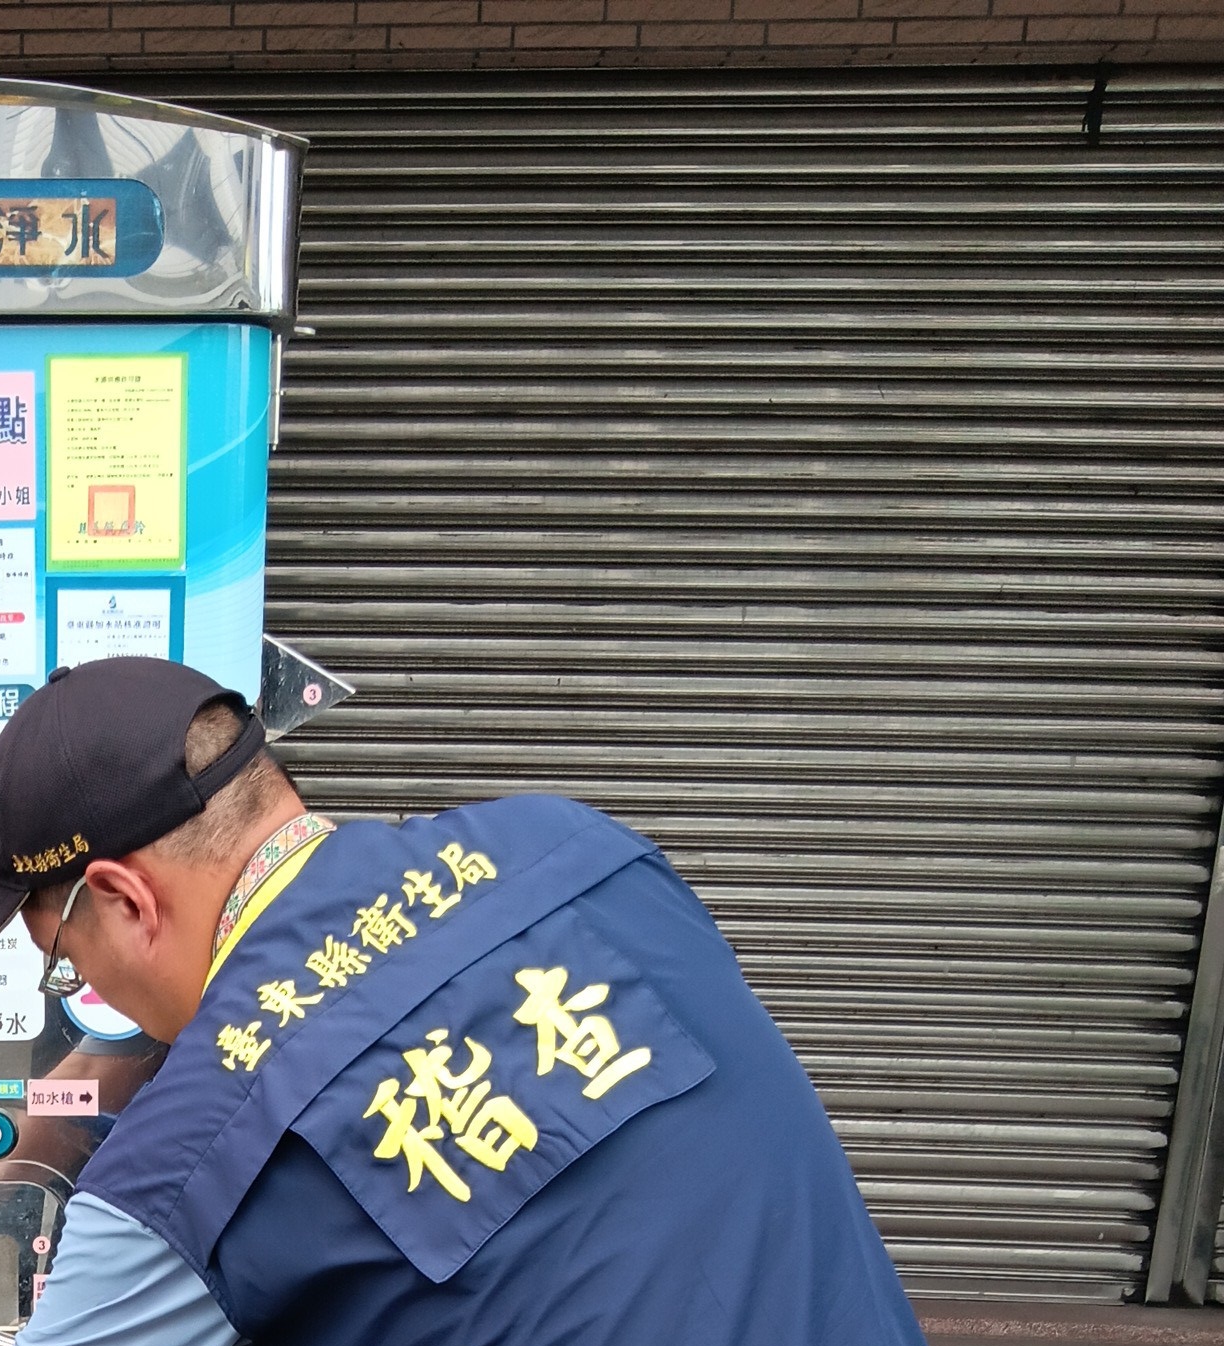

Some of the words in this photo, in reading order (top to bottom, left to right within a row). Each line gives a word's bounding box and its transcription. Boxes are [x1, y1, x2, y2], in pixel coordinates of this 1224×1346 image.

[309, 689, 316, 700] 3
[216, 843, 498, 1072] 臺東縣衛生局
[362, 967, 652, 1202] 稽查
[32, 1091, 74, 1105] 加水槍
[38, 1240, 45, 1250] 3
